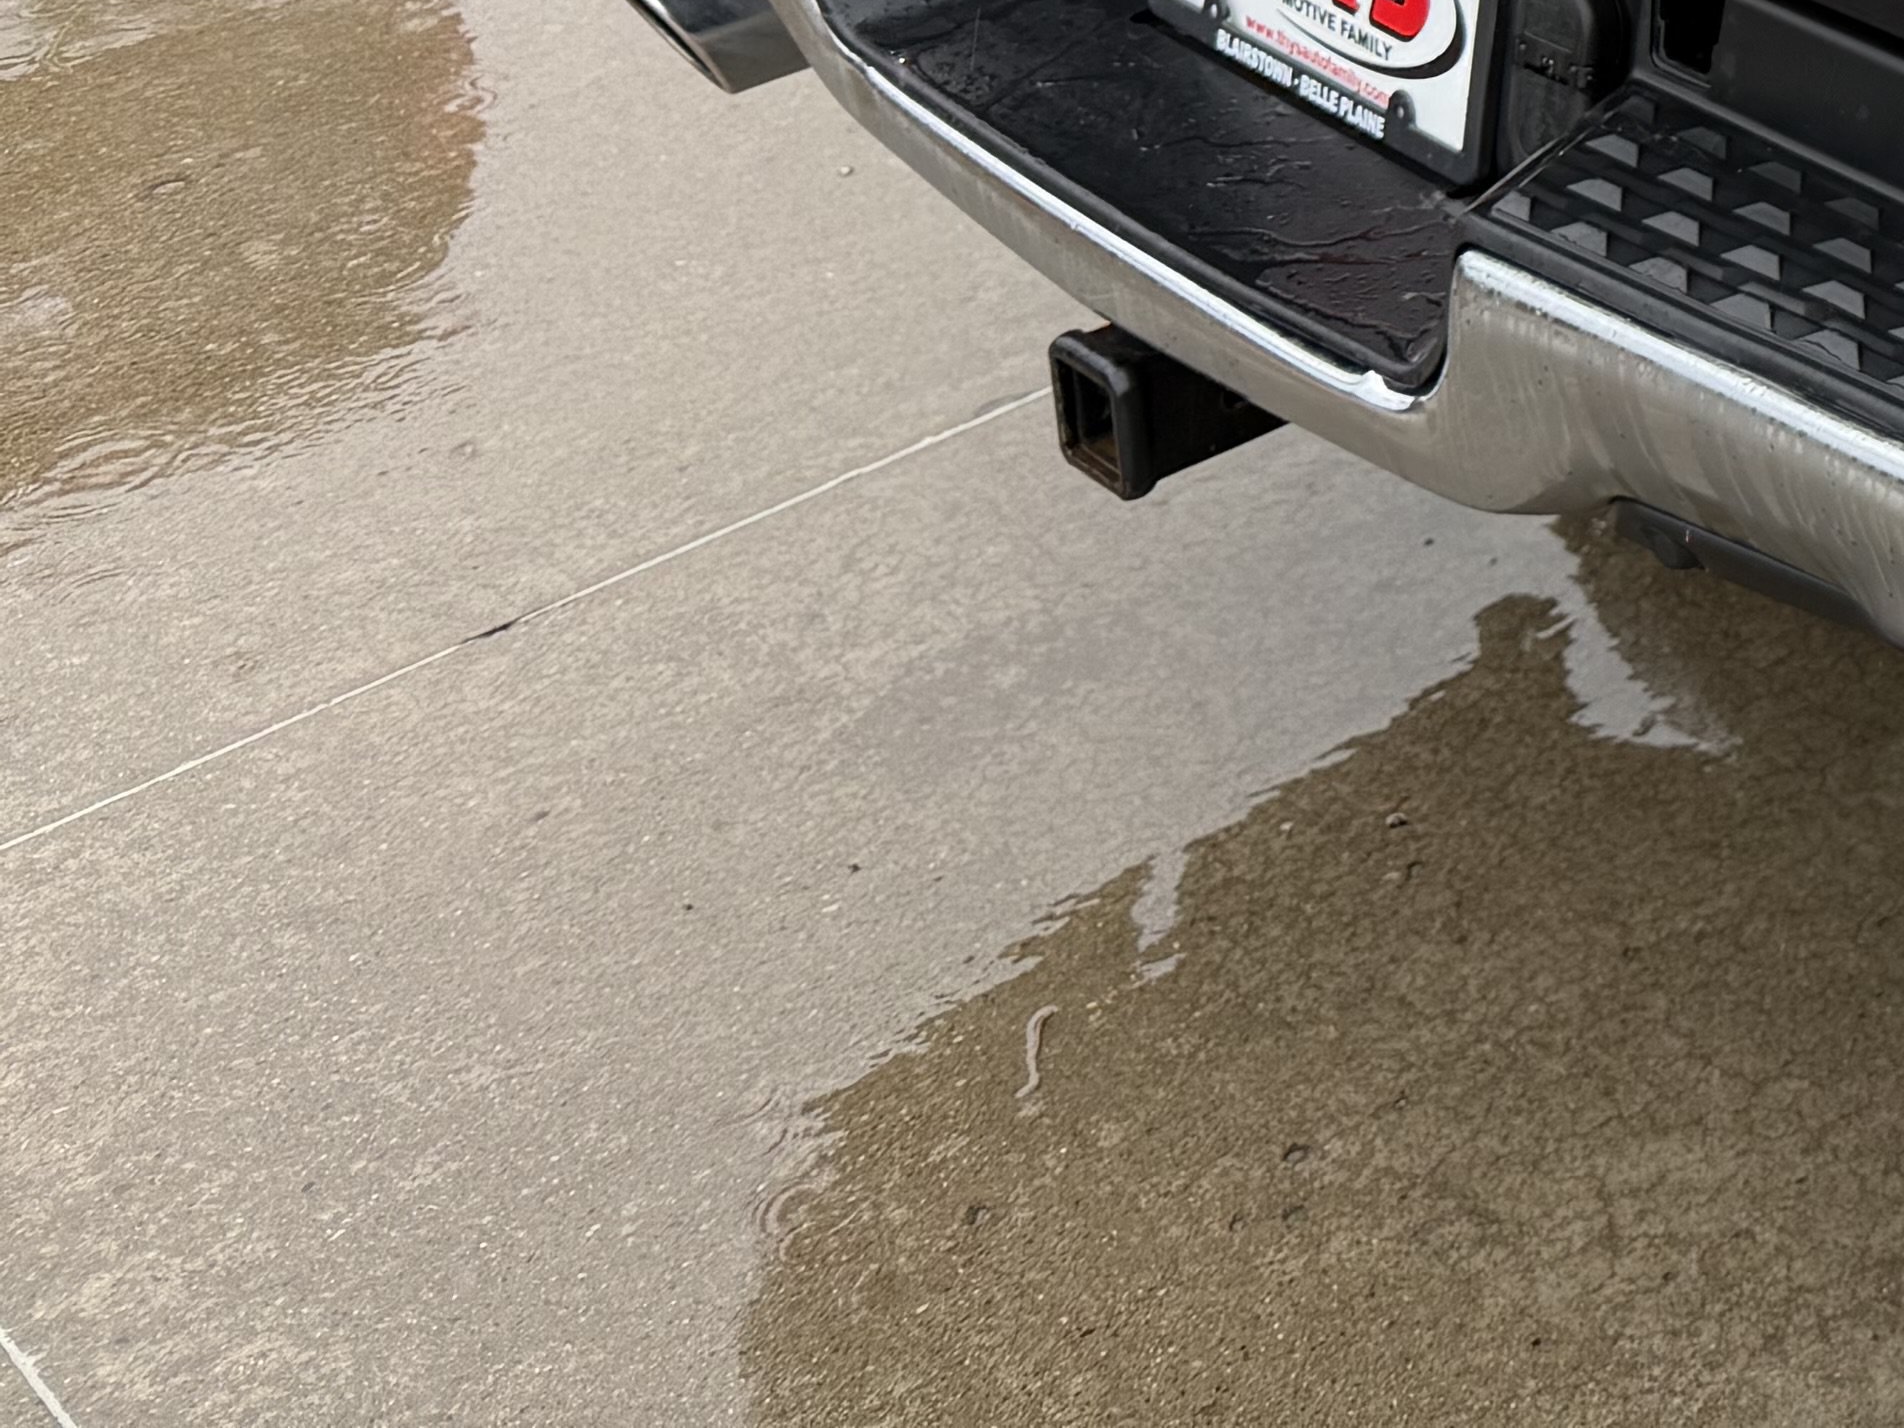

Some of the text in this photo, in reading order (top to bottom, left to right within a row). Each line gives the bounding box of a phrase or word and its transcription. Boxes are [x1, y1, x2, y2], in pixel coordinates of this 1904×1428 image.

[1340, 18, 1393, 61] FAMILY
[1215, 28, 1386, 139] BLAIRSTOWN BELLE PLAINE
